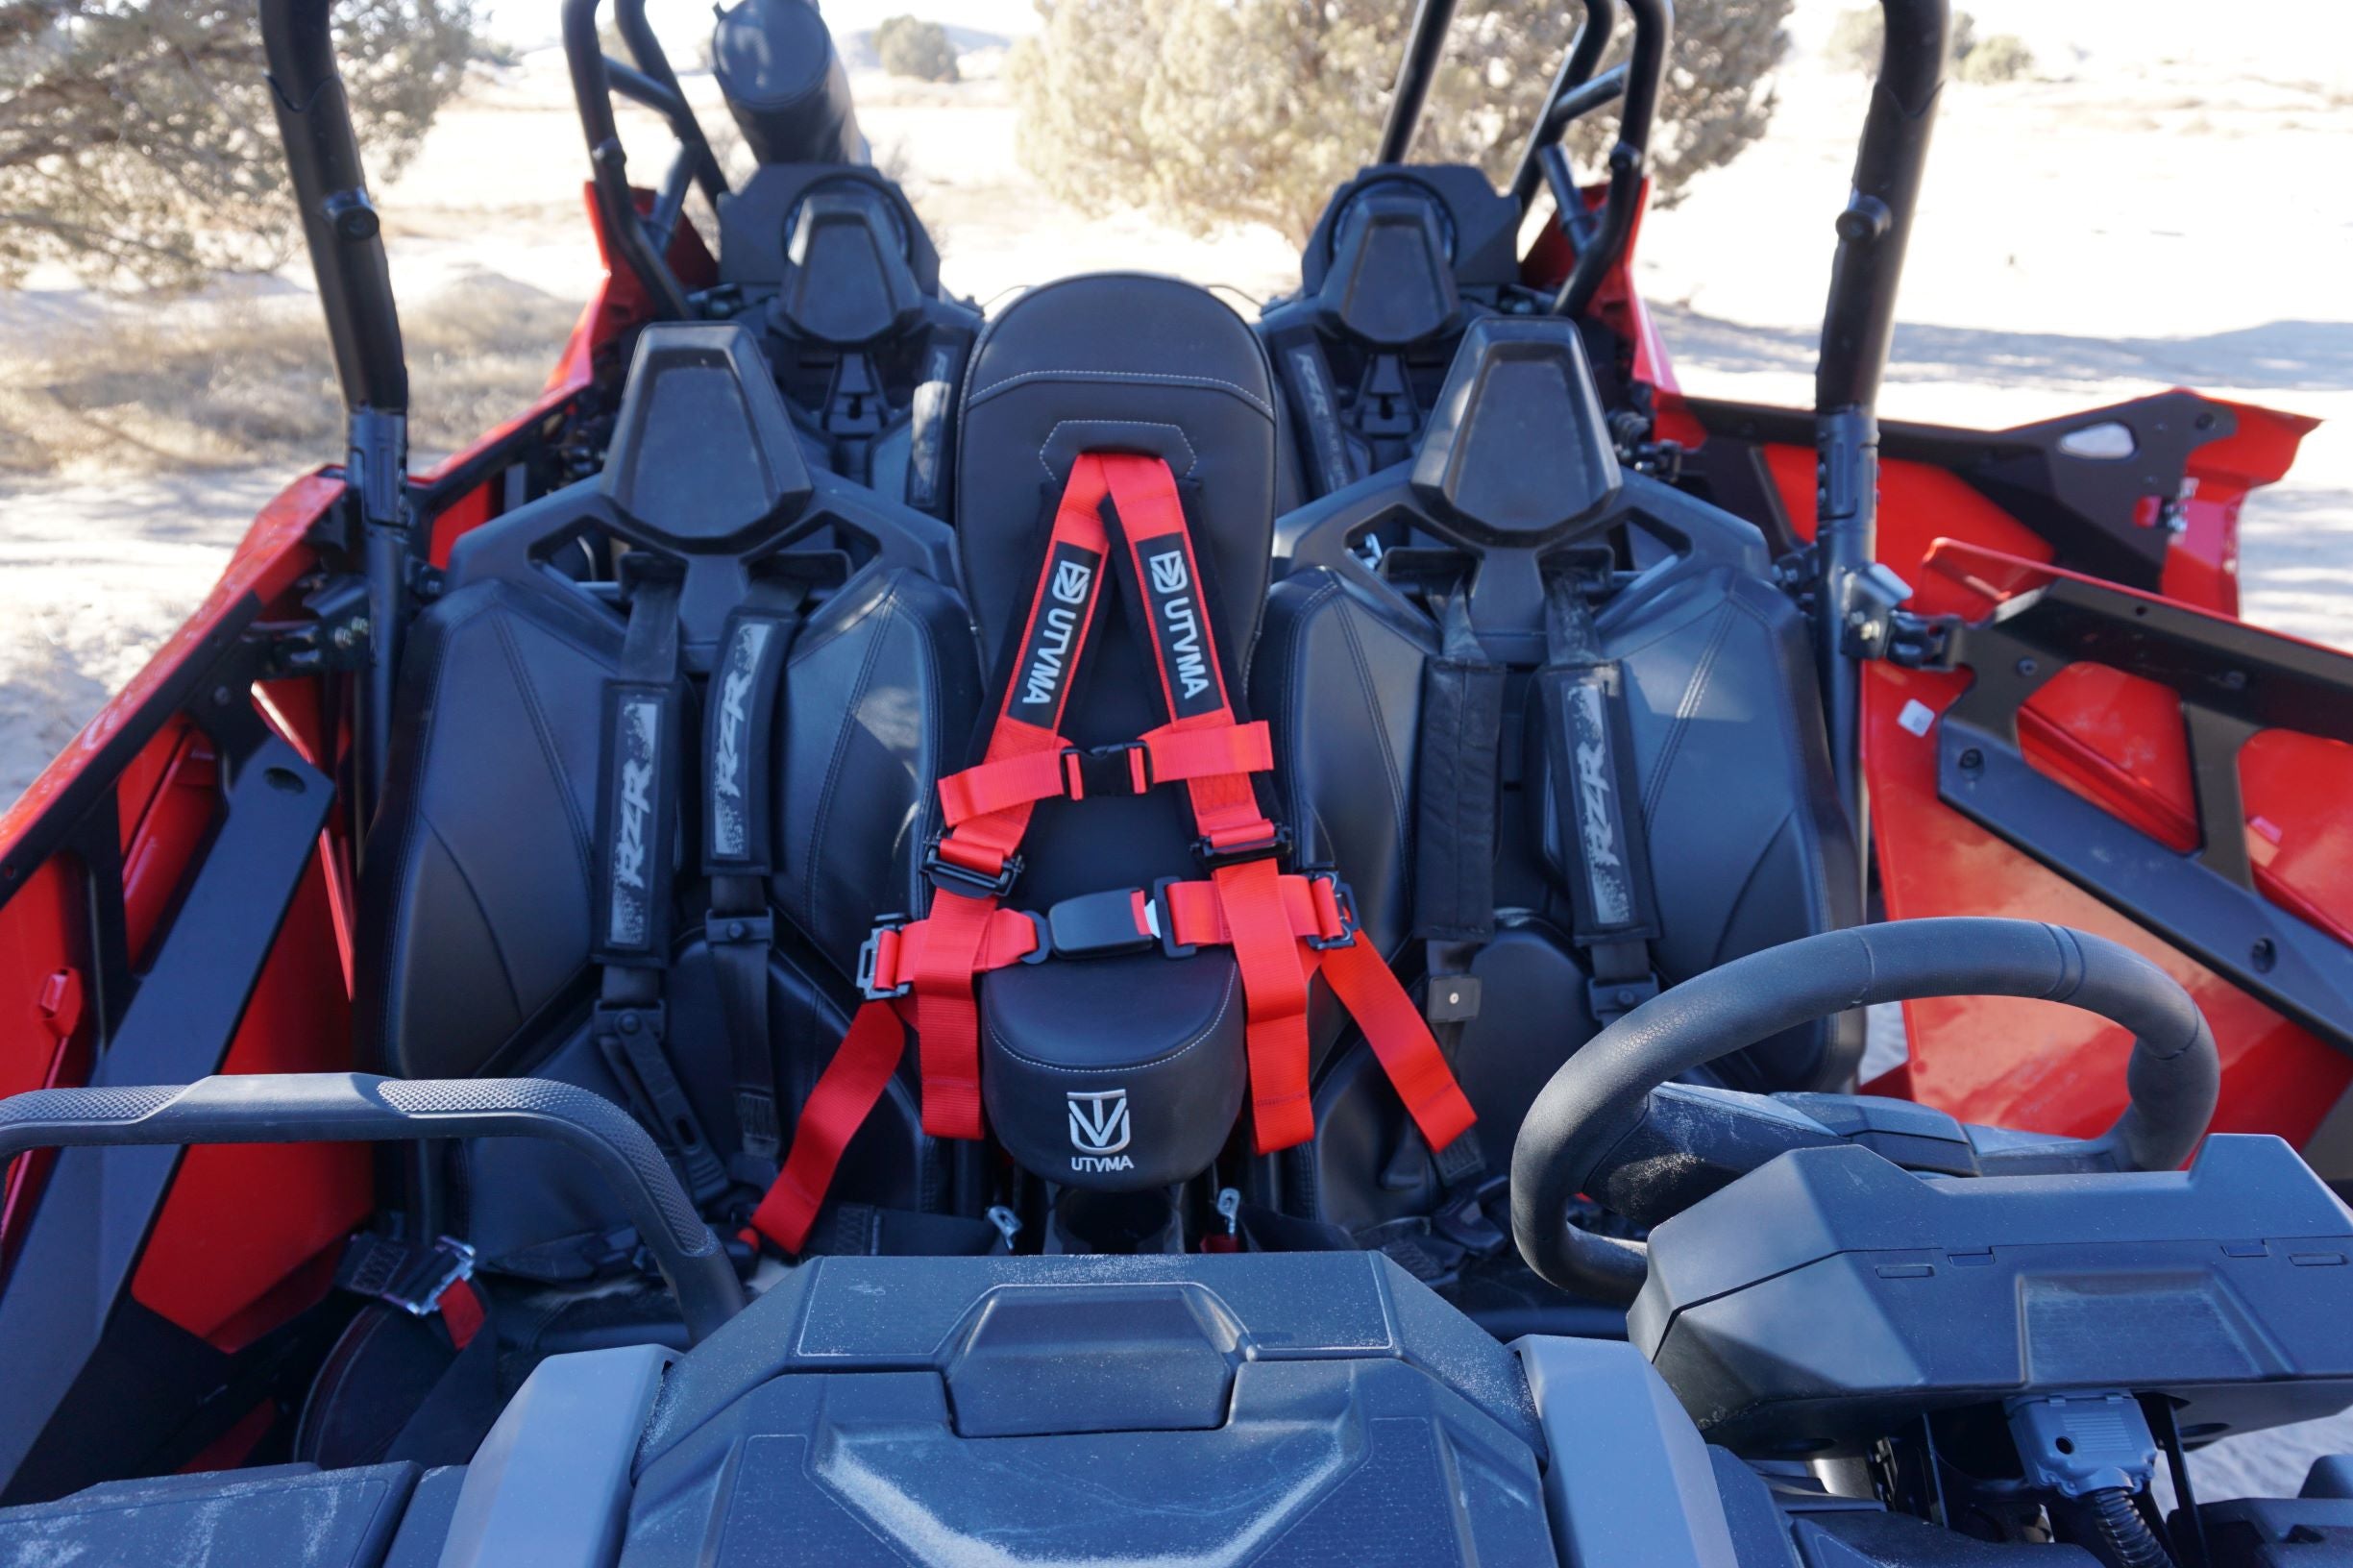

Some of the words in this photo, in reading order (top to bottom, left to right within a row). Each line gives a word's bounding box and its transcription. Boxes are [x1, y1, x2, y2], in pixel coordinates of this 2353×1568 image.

[1021, 611, 1077, 703] UTVMA
[1164, 598, 1210, 699] UTVMA
[716, 670, 752, 797] RZR
[615, 759, 652, 889] RZR
[1577, 741, 1621, 866] RZR
[1071, 1155, 1135, 1173] UTVMA
